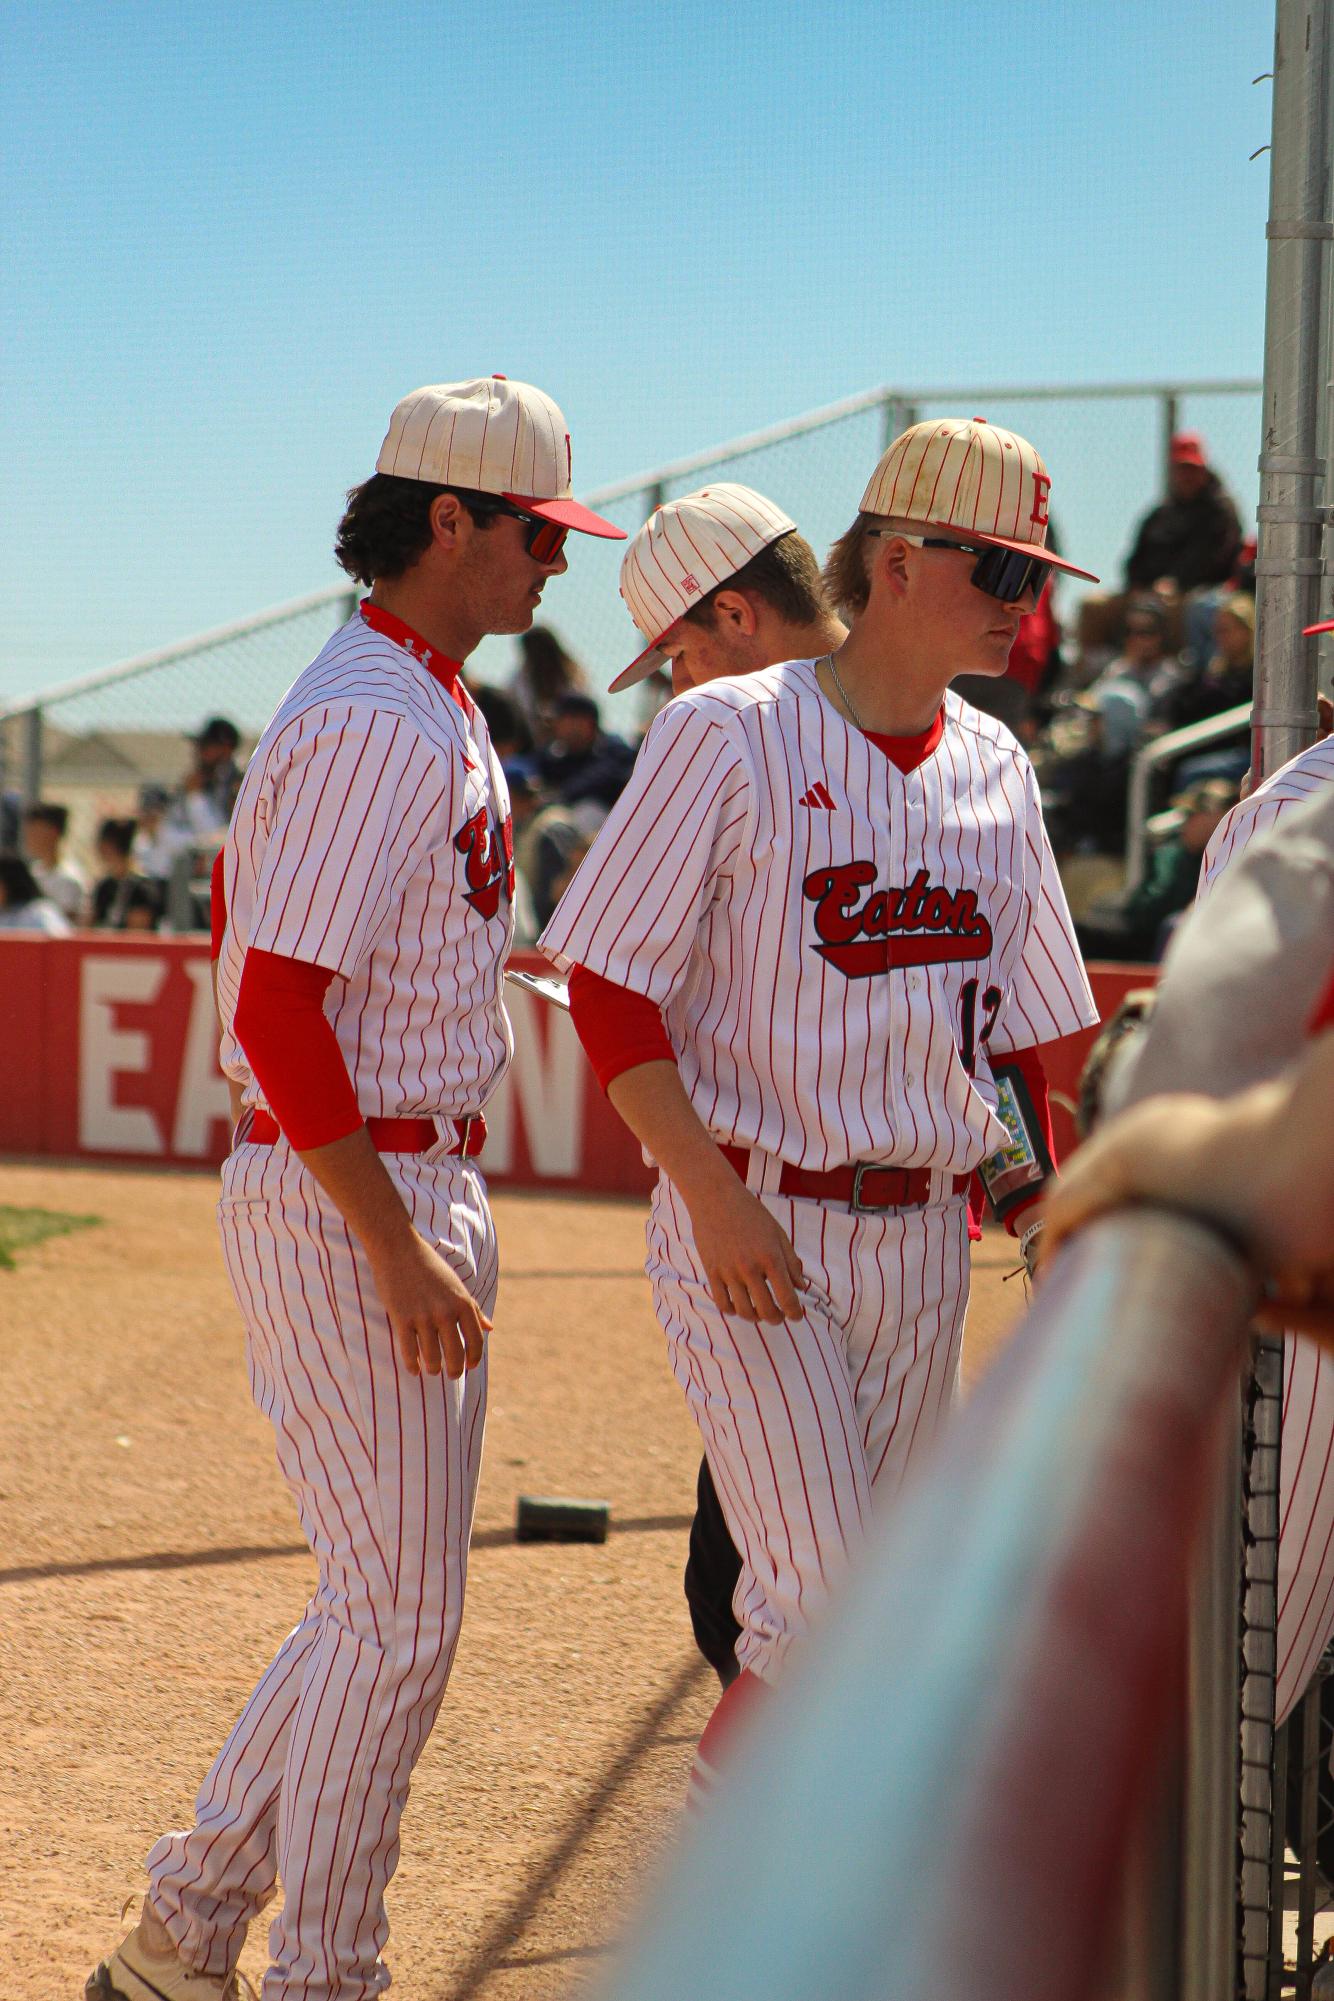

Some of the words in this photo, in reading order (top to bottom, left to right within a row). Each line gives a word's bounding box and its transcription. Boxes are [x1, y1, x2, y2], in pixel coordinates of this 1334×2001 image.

[1030, 472, 1051, 526] E
[803, 860, 990, 946] Eaton
[79, 954, 584, 1179] EAN
